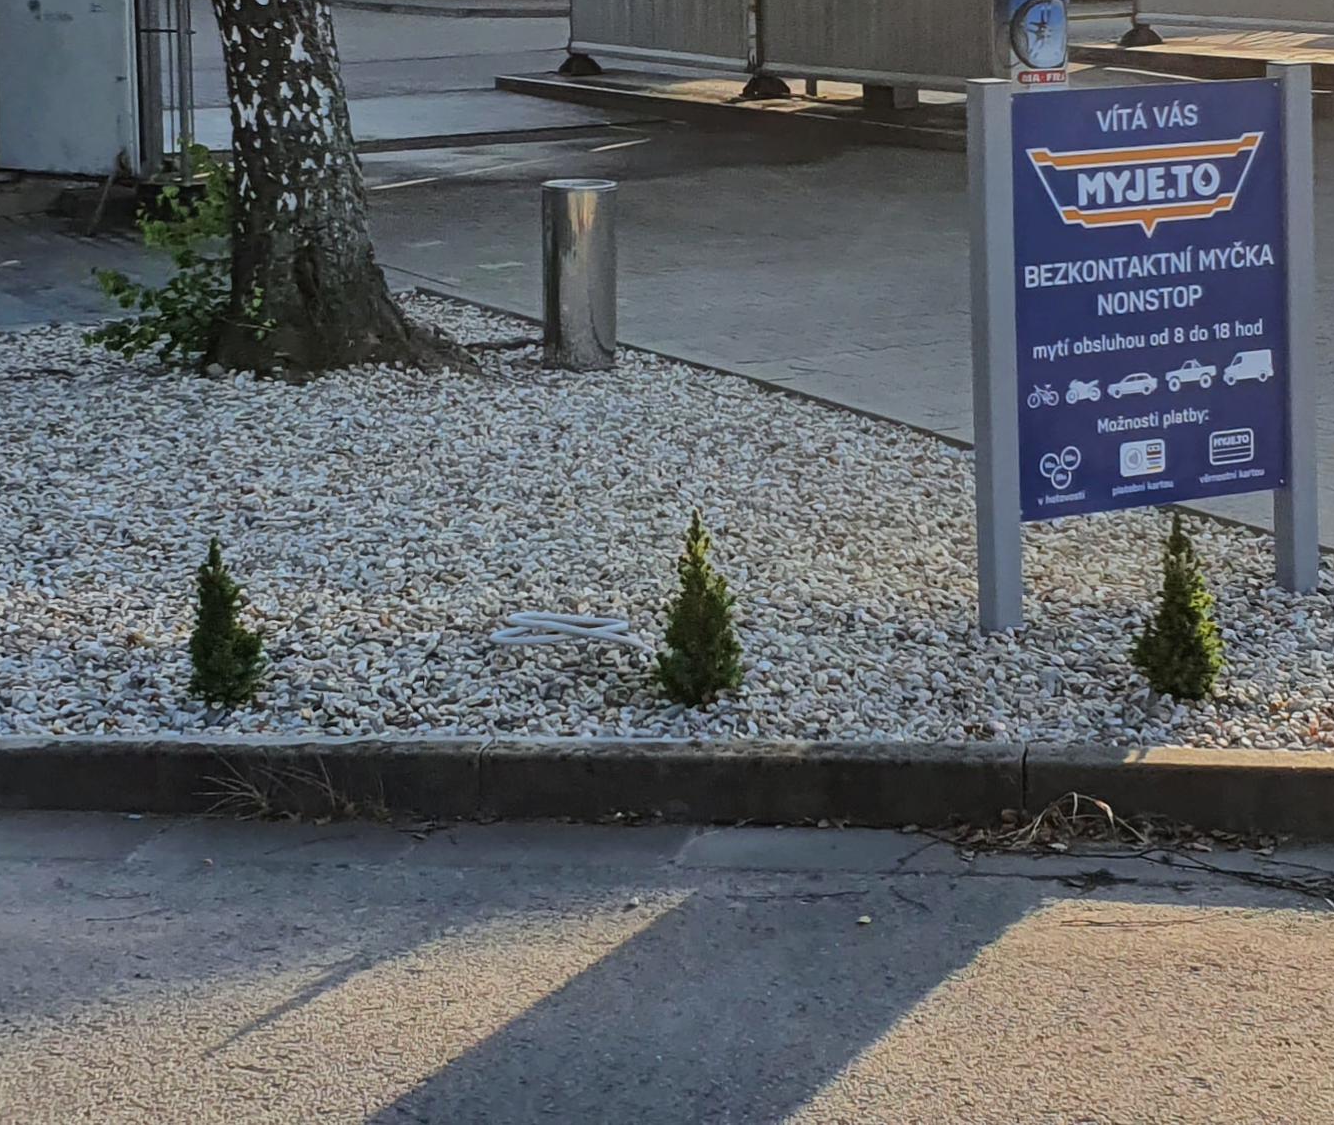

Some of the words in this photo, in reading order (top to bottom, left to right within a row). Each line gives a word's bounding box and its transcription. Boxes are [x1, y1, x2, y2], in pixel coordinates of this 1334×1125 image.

[1096, 102, 1147, 132] VÍTÁ
[1153, 100, 1198, 127] VÁS
[1024, 246, 1192, 288] BEZKONTAKTNÍ
[1198, 241, 1274, 272] MYČKA
[1097, 285, 1202, 316] NONSTOP
[1033, 338, 1068, 361] mytí
[1073, 333, 1145, 356] obsluhou
[1150, 328, 1169, 346] od
[1174, 326, 1184, 343] 8
[1189, 325, 1208, 342] do
[1213, 323, 1229, 339] 18
[1235, 318, 1263, 336] hod
[1097, 411, 1159, 434] Možnosti
[1163, 408, 1209, 429] platby:
